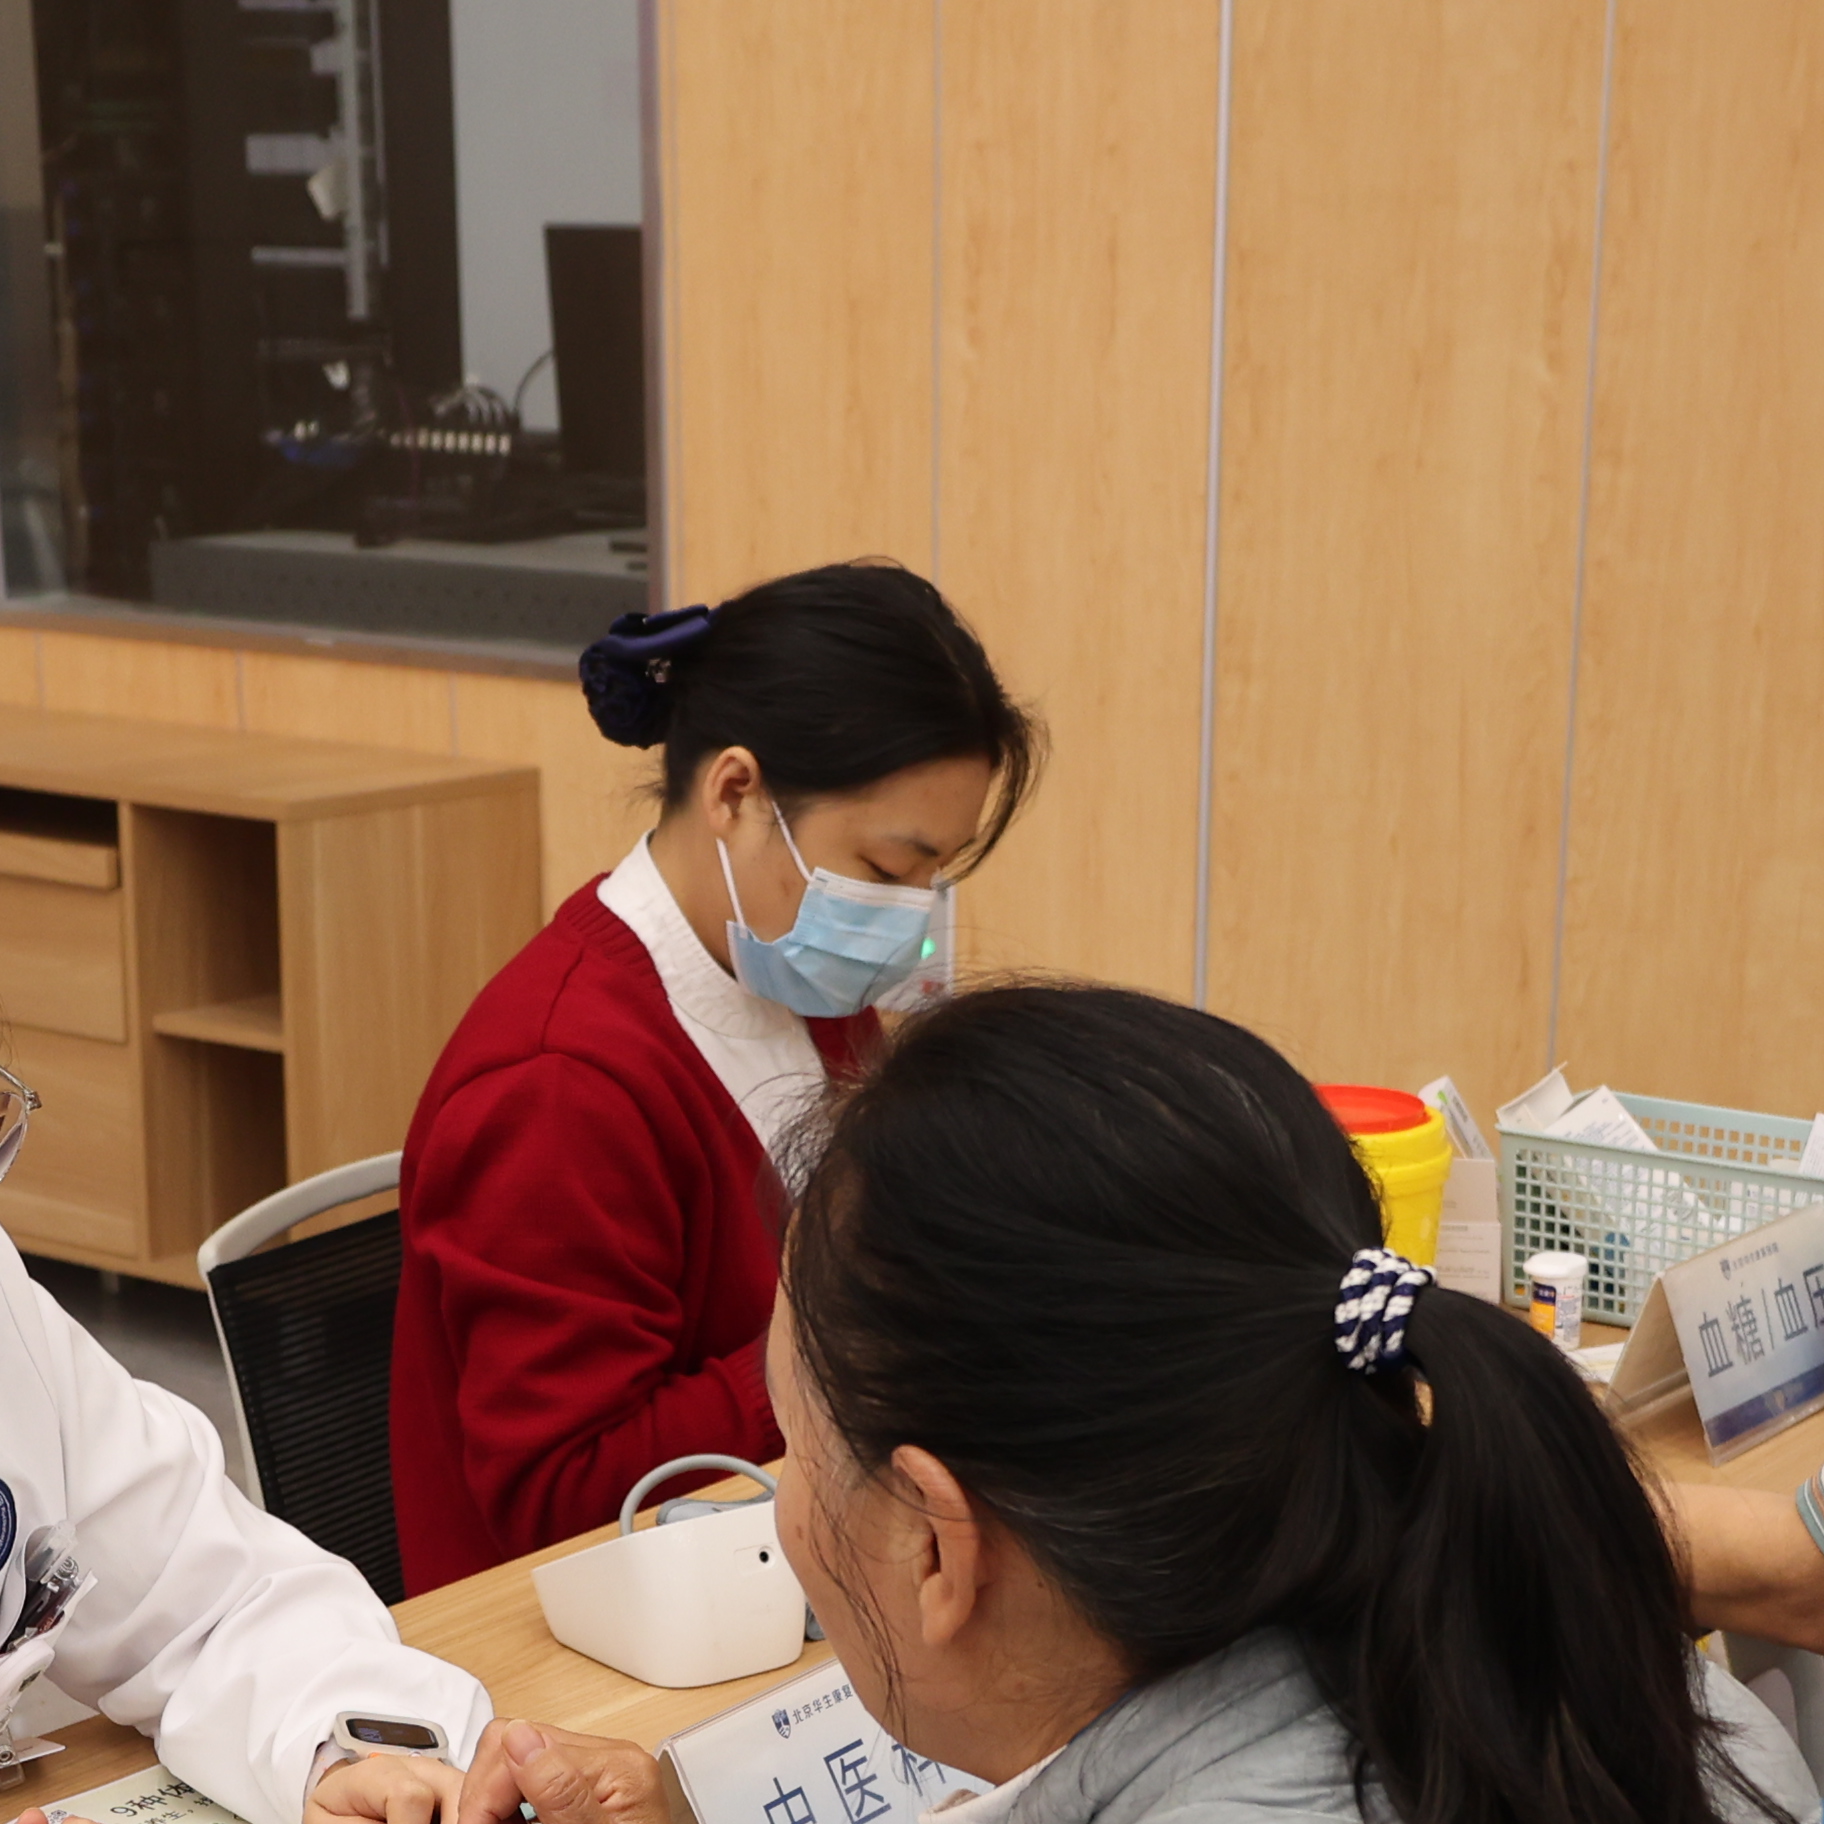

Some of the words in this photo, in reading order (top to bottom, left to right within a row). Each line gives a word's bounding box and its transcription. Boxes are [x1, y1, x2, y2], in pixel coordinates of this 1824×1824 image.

[792, 1684, 854, 1725] 北京华生康复
